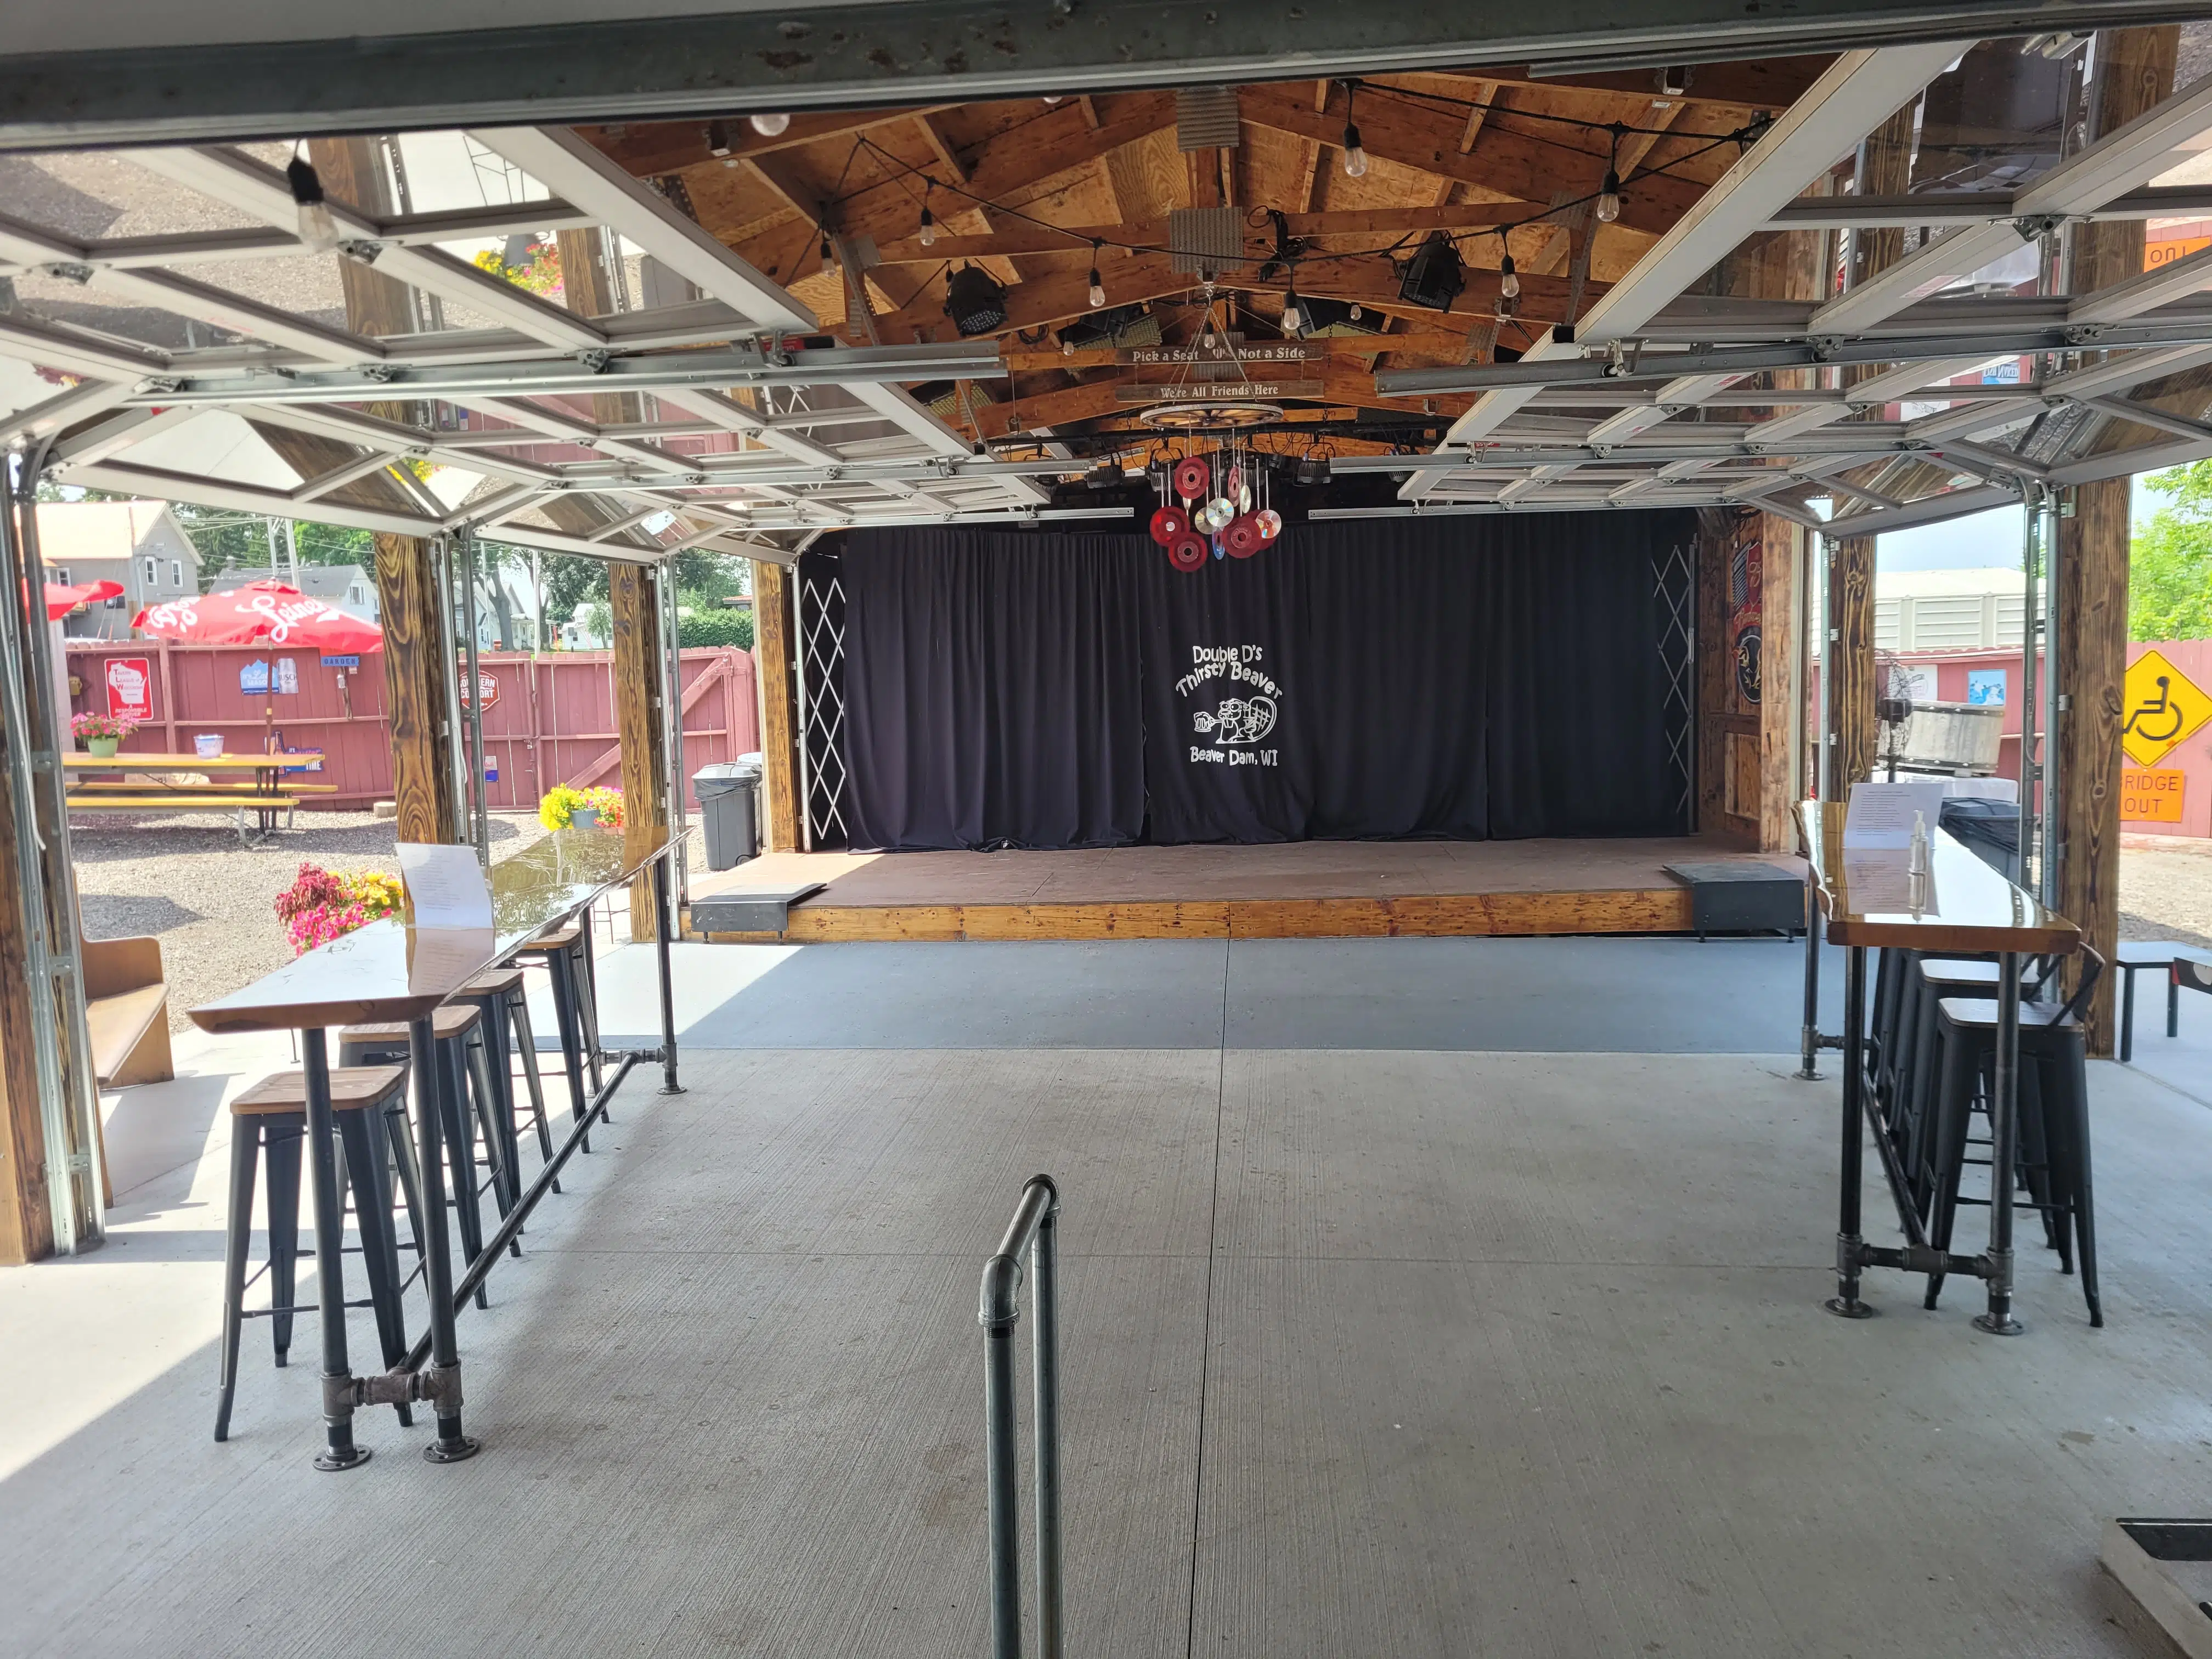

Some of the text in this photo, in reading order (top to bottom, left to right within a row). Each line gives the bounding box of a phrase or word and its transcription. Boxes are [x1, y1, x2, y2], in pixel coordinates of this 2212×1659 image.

[1132, 347, 1306, 362] Pick a Seat Not a Side
[1160, 384, 1279, 398] We're All Friends Here
[1192, 644, 1263, 664] Double D's
[1175, 661, 1283, 699] Thirsty Beaver
[1189, 746, 1278, 766] Beaver Dam, WI
[2120, 775, 2179, 791] RIDGE
[2124, 798, 2164, 814] OUT
